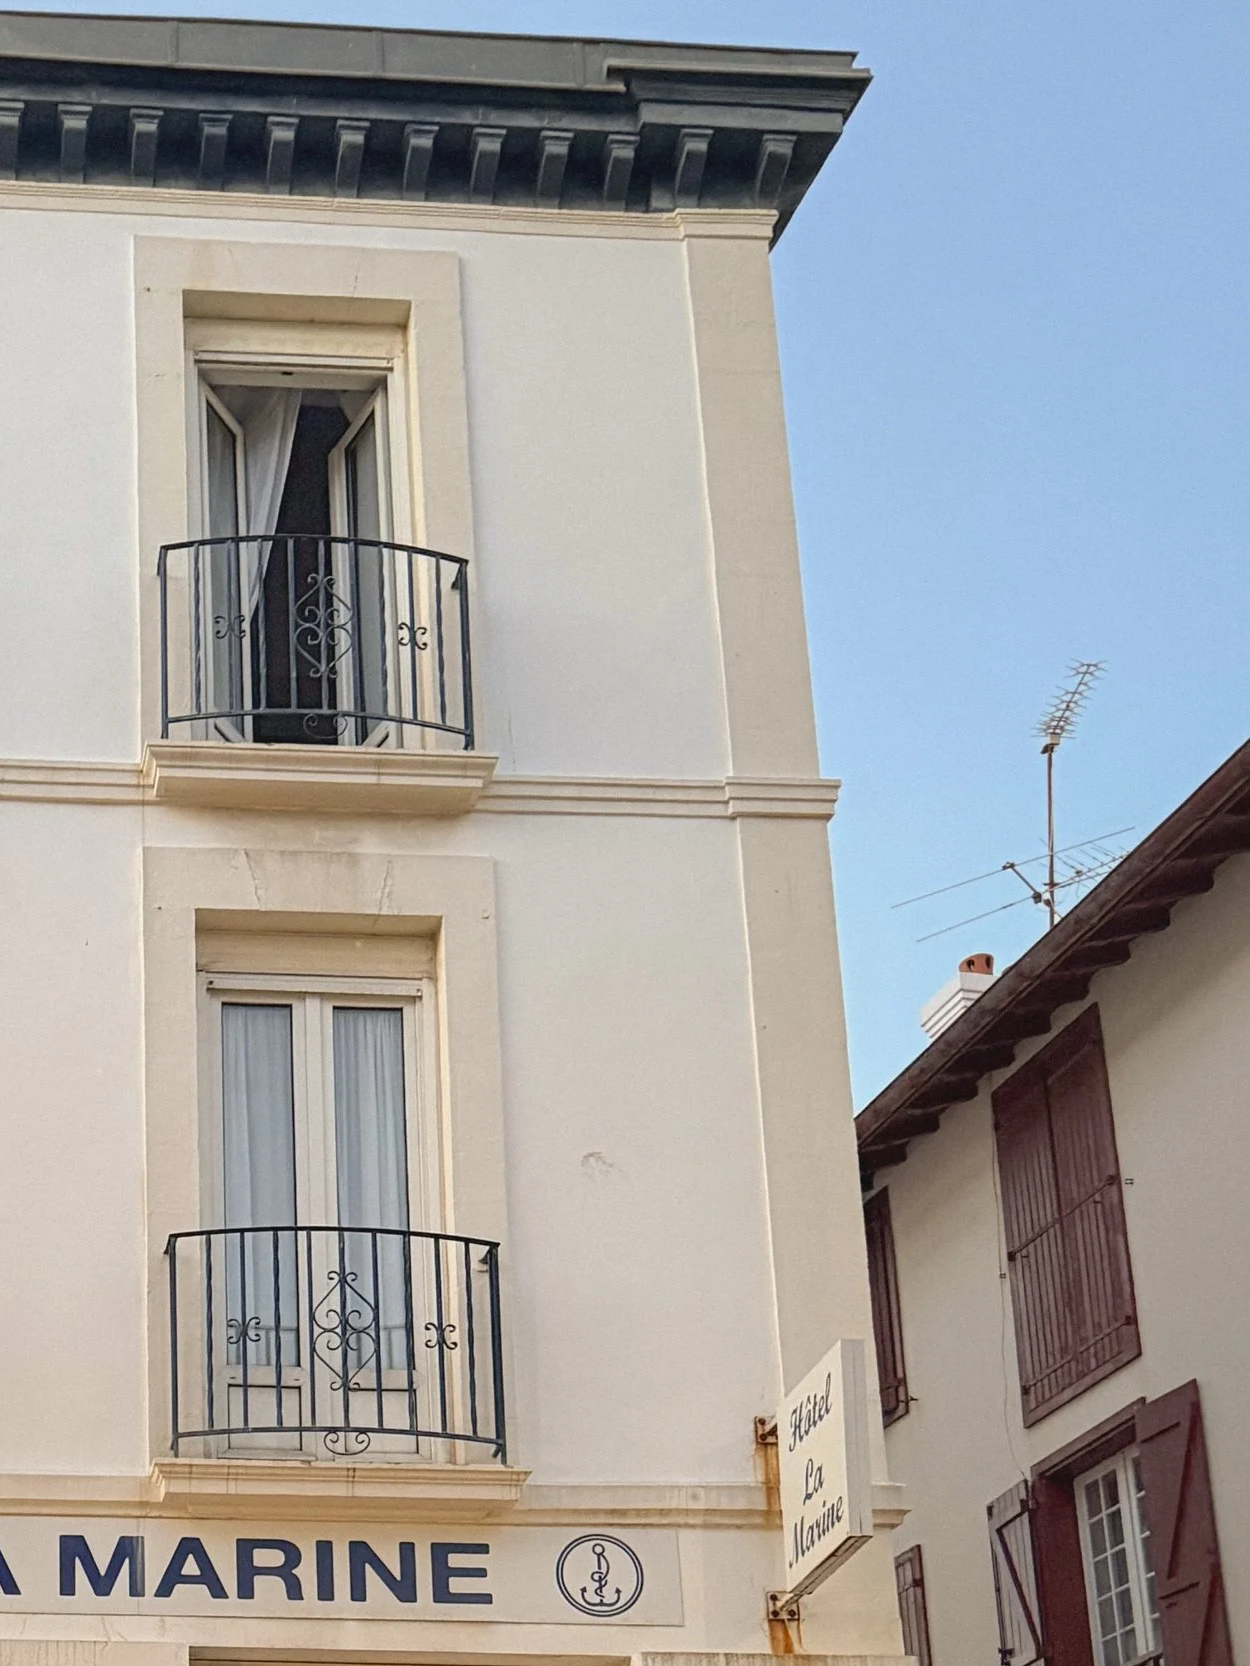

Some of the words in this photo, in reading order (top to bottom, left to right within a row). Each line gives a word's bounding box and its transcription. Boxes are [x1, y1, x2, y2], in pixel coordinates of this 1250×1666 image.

[788, 1371, 833, 1453] Hôtel
[803, 1457, 825, 1506] La
[789, 1495, 845, 1569] Marine
[59, 1534, 494, 1605] MARINE
